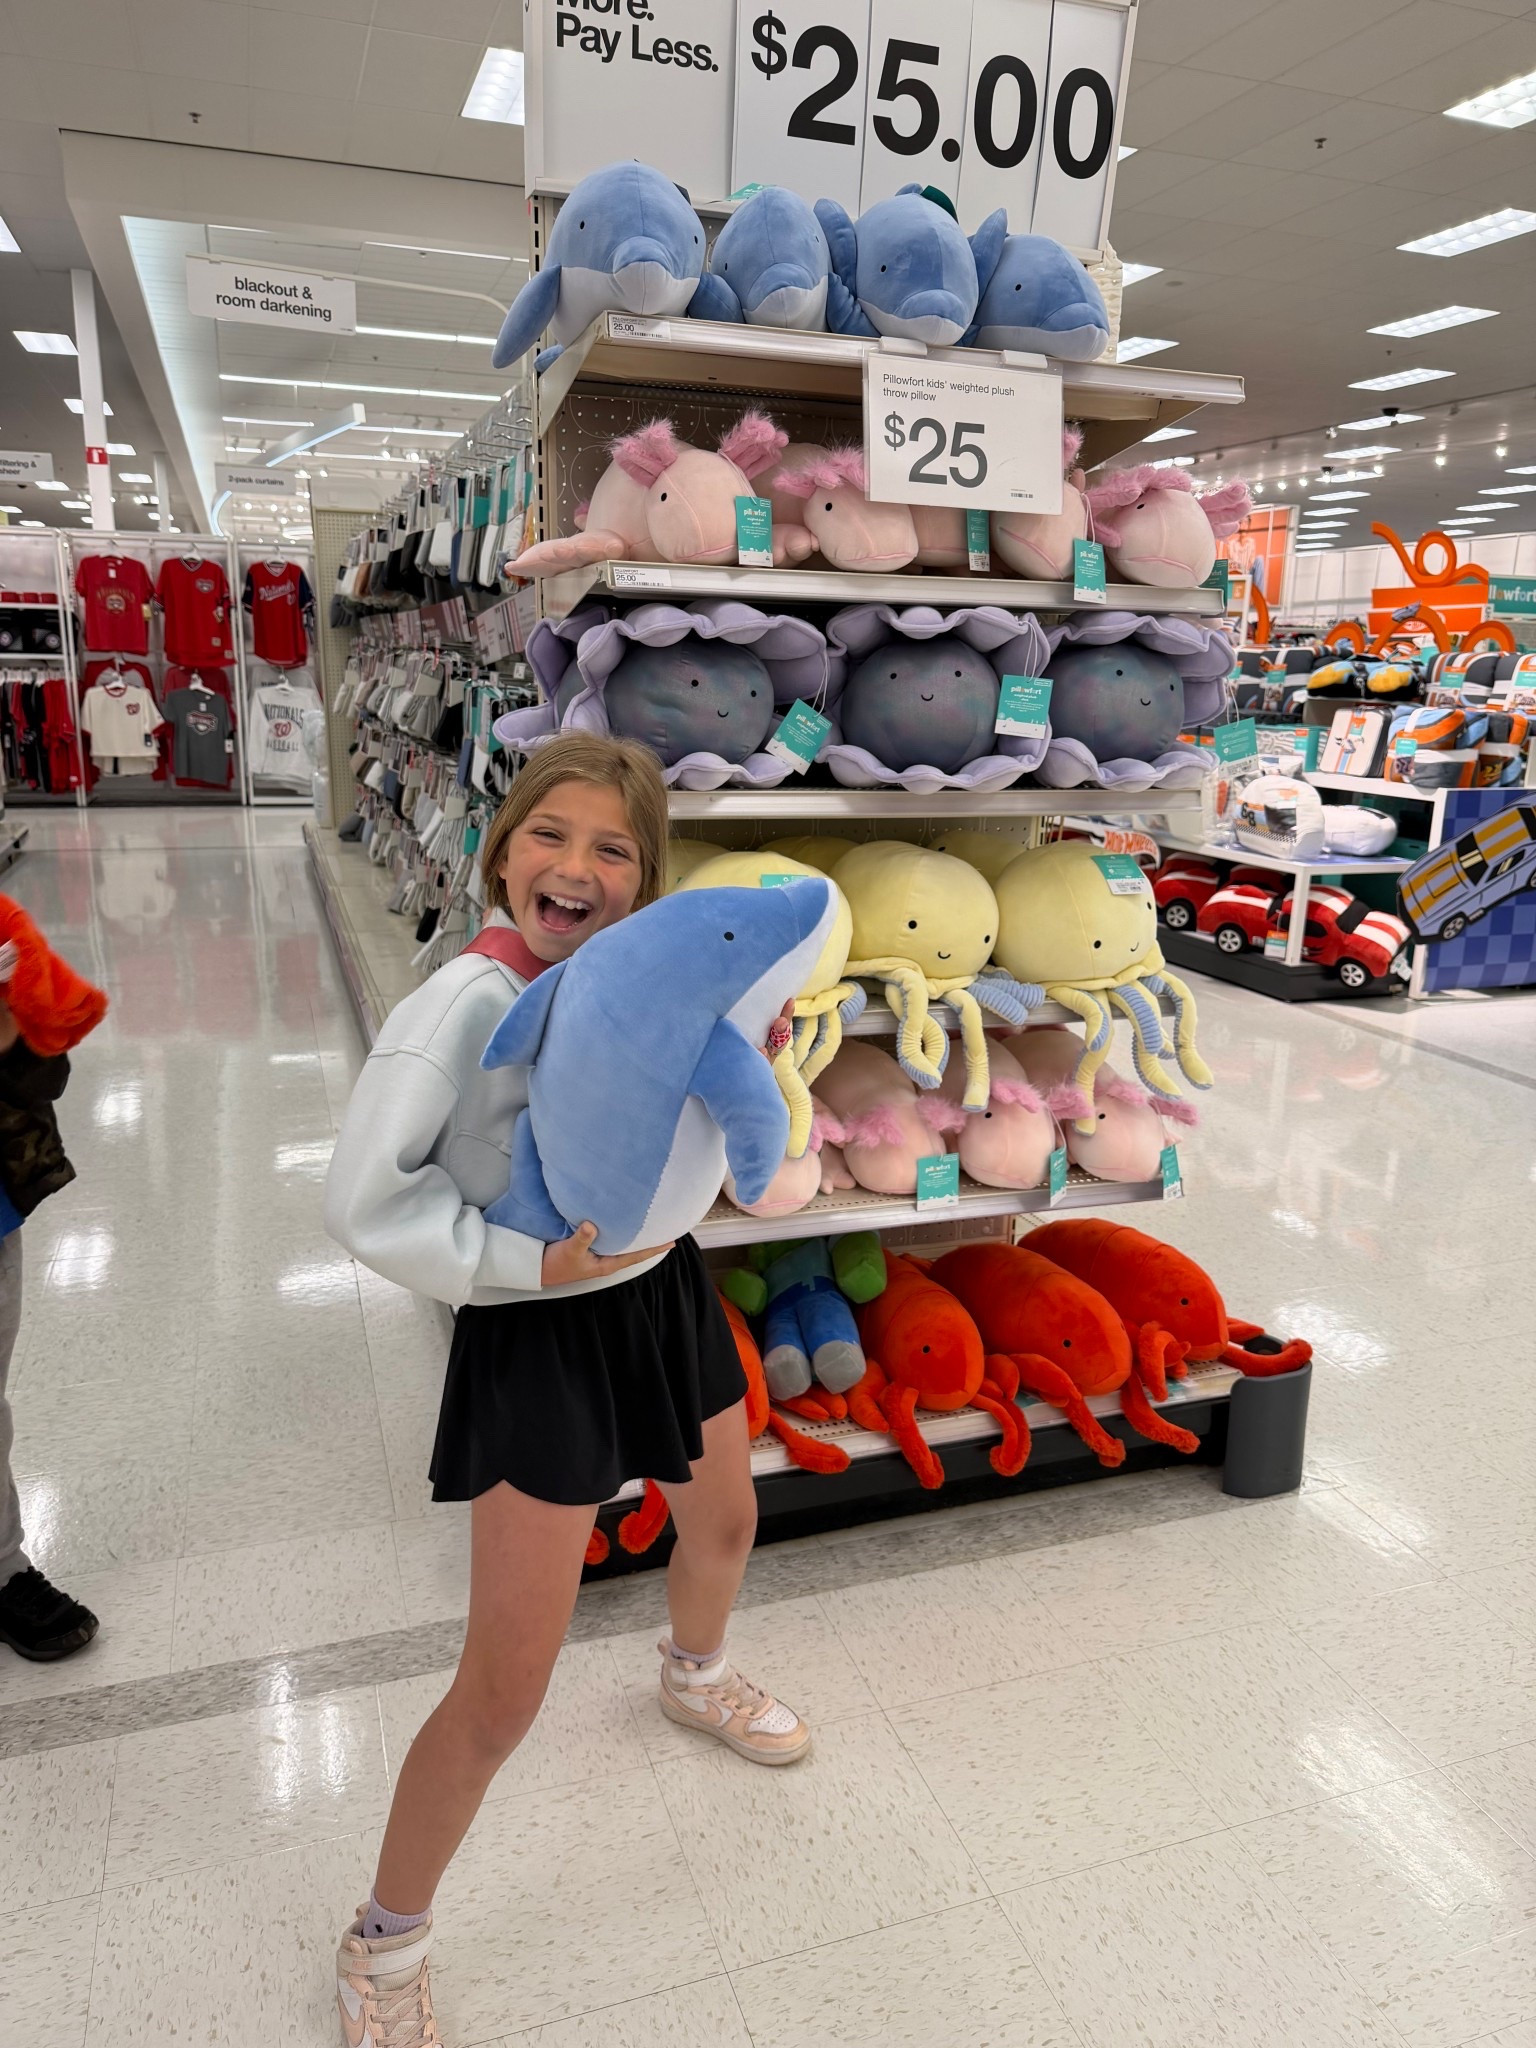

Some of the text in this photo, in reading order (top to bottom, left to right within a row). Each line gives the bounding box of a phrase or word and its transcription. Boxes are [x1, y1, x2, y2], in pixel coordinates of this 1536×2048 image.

[556, 11, 719, 72] Pay Less.
[751, 9, 1114, 179] $25.00
[234, 276, 313, 300] blackout &
[216, 294, 332, 322] room darkening
[613, 323, 635, 332] 25.00
[883, 373, 1015, 397] Pillowfort kids' weighted plush
[883, 388, 937, 402] throw pillow
[884, 411, 988, 488] $25
[228, 475, 285, 486] 2-pack curtains
[616, 574, 637, 582] 25.00
[1489, 584, 1536, 602] llowfort
[1011, 686, 1042, 695] pillowfort
[1241, 802, 1256, 827] 68
